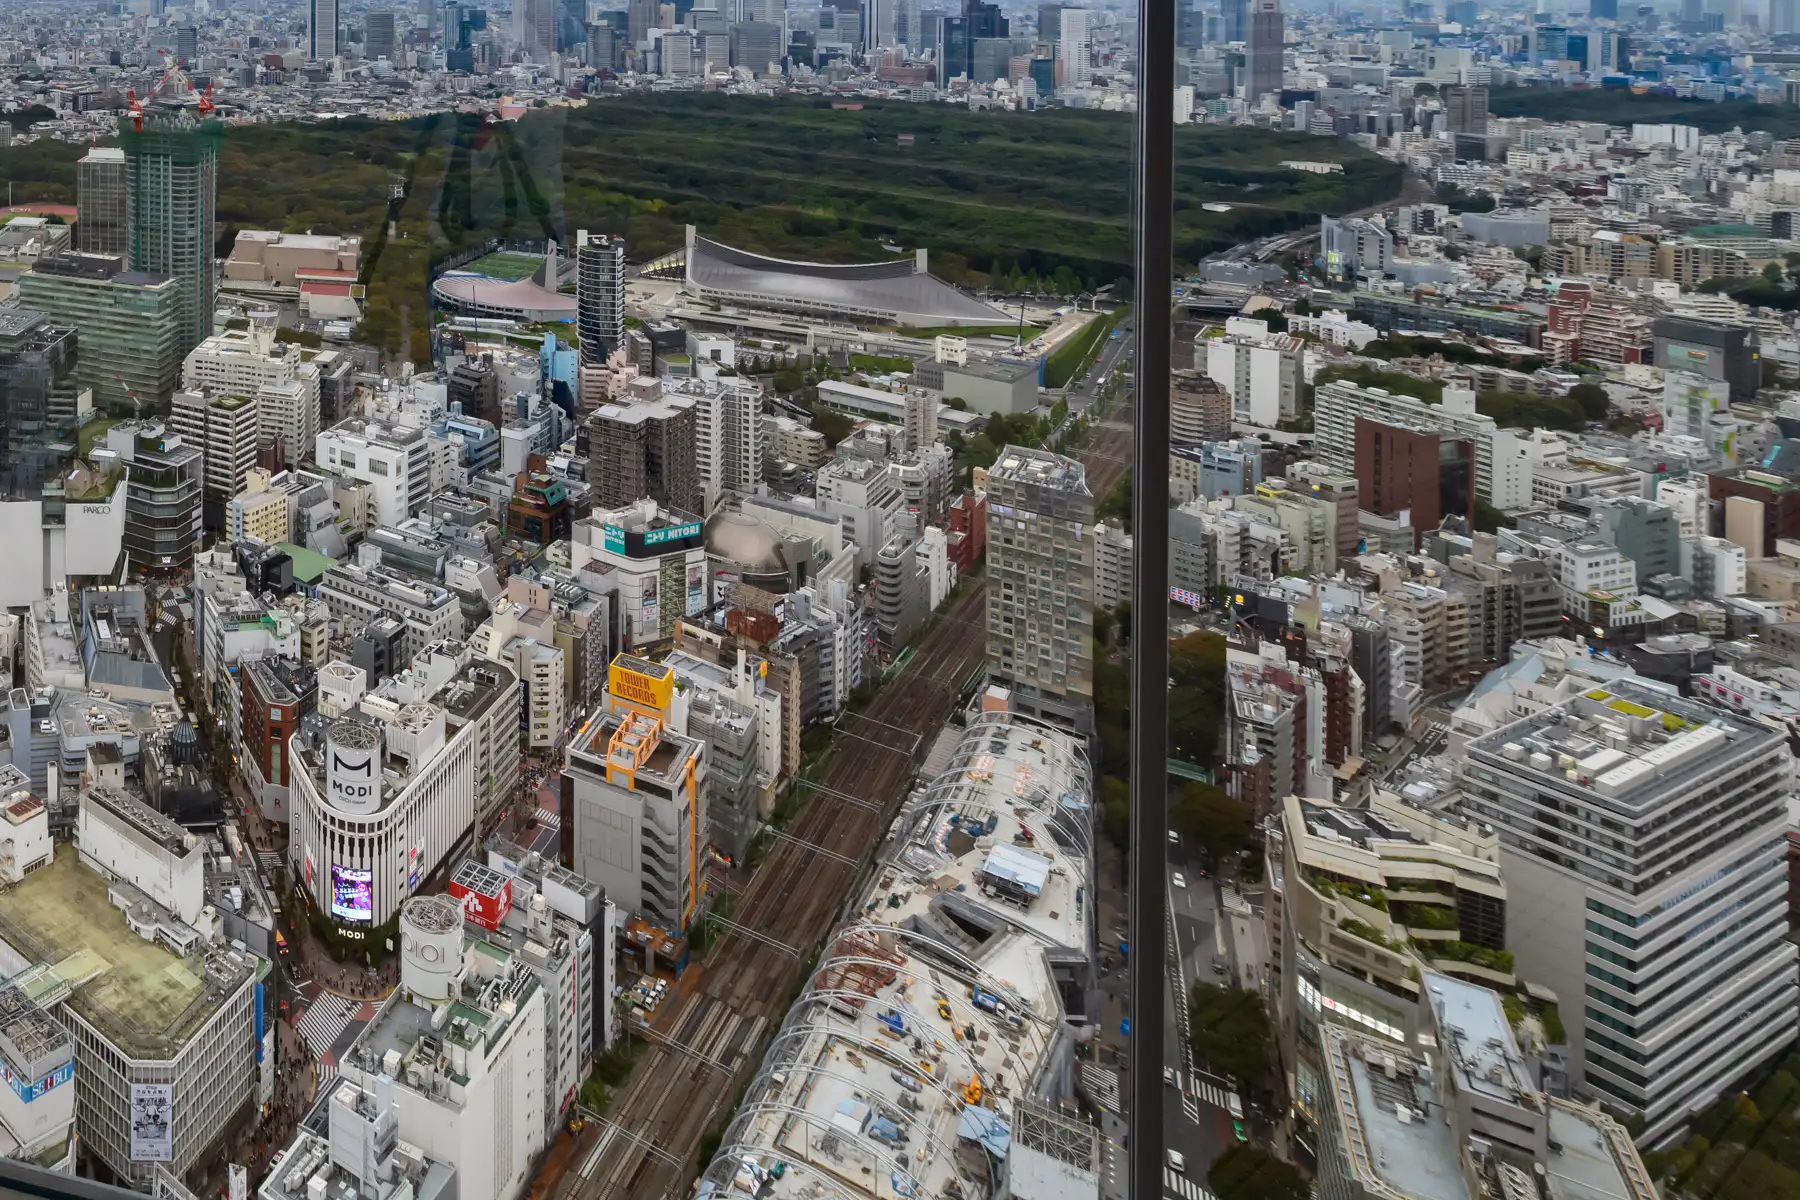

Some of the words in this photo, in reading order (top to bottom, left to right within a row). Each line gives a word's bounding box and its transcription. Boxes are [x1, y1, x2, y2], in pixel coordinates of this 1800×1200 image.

[83, 505, 111, 515] PARCO
[668, 524, 700, 540] NITORI
[620, 670, 651, 690] TOWER
[616, 682, 657, 706] RECORDS
[332, 779, 372, 797] MODI
[274, 798, 281, 808] R
[338, 927, 365, 940] MODI
